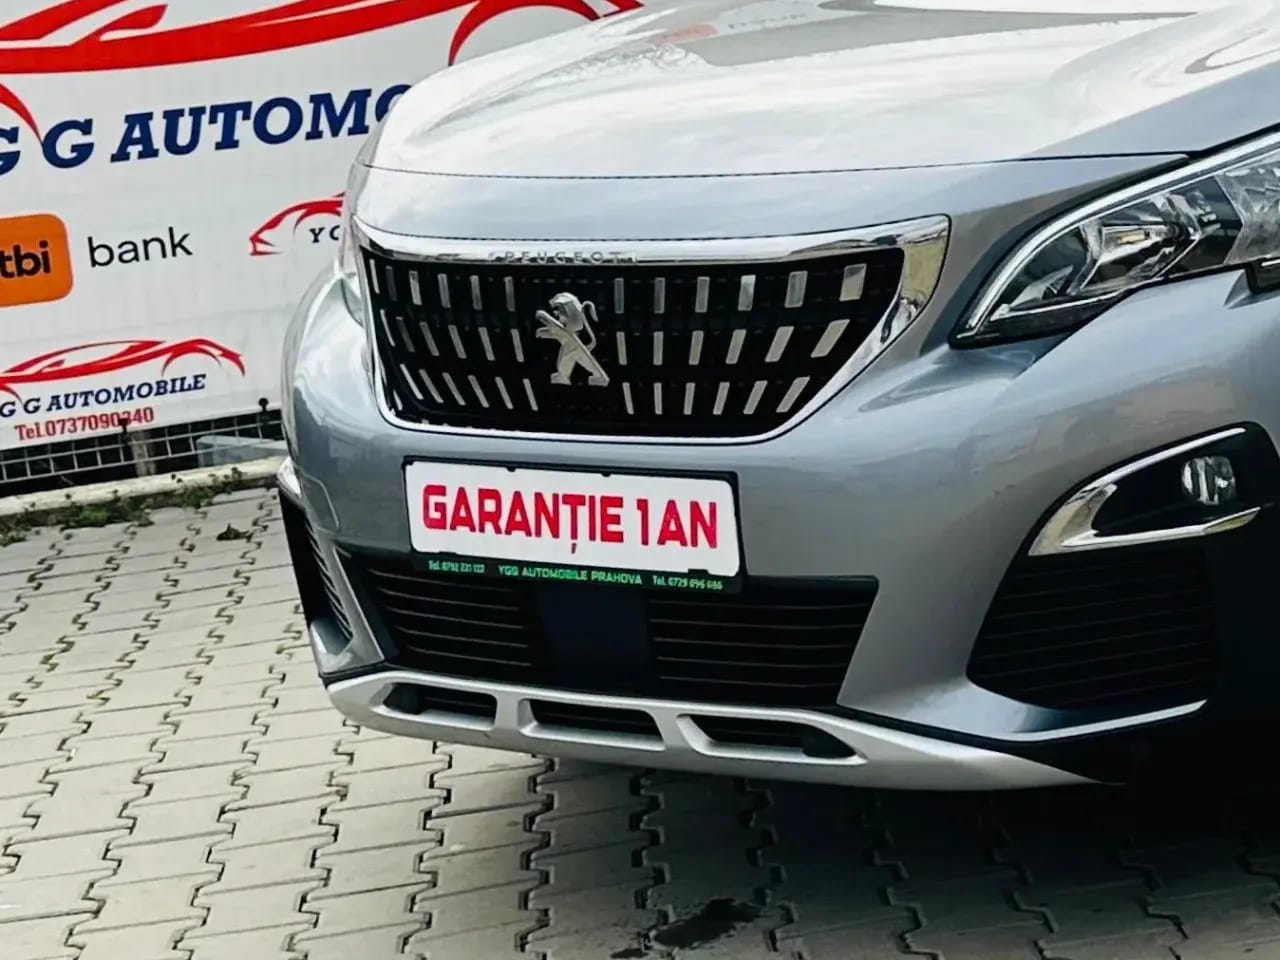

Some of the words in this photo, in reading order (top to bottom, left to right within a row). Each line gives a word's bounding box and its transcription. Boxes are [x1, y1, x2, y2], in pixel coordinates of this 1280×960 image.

[88, 226, 193, 268] bank
[504, 250, 622, 264] PEUGEOT
[46, 374, 207, 412] AUTOMOBILE
[422, 484, 625, 555] GARANȚIE
[657, 499, 718, 549] AN
[591, 570, 643, 585] PRAHOVA
